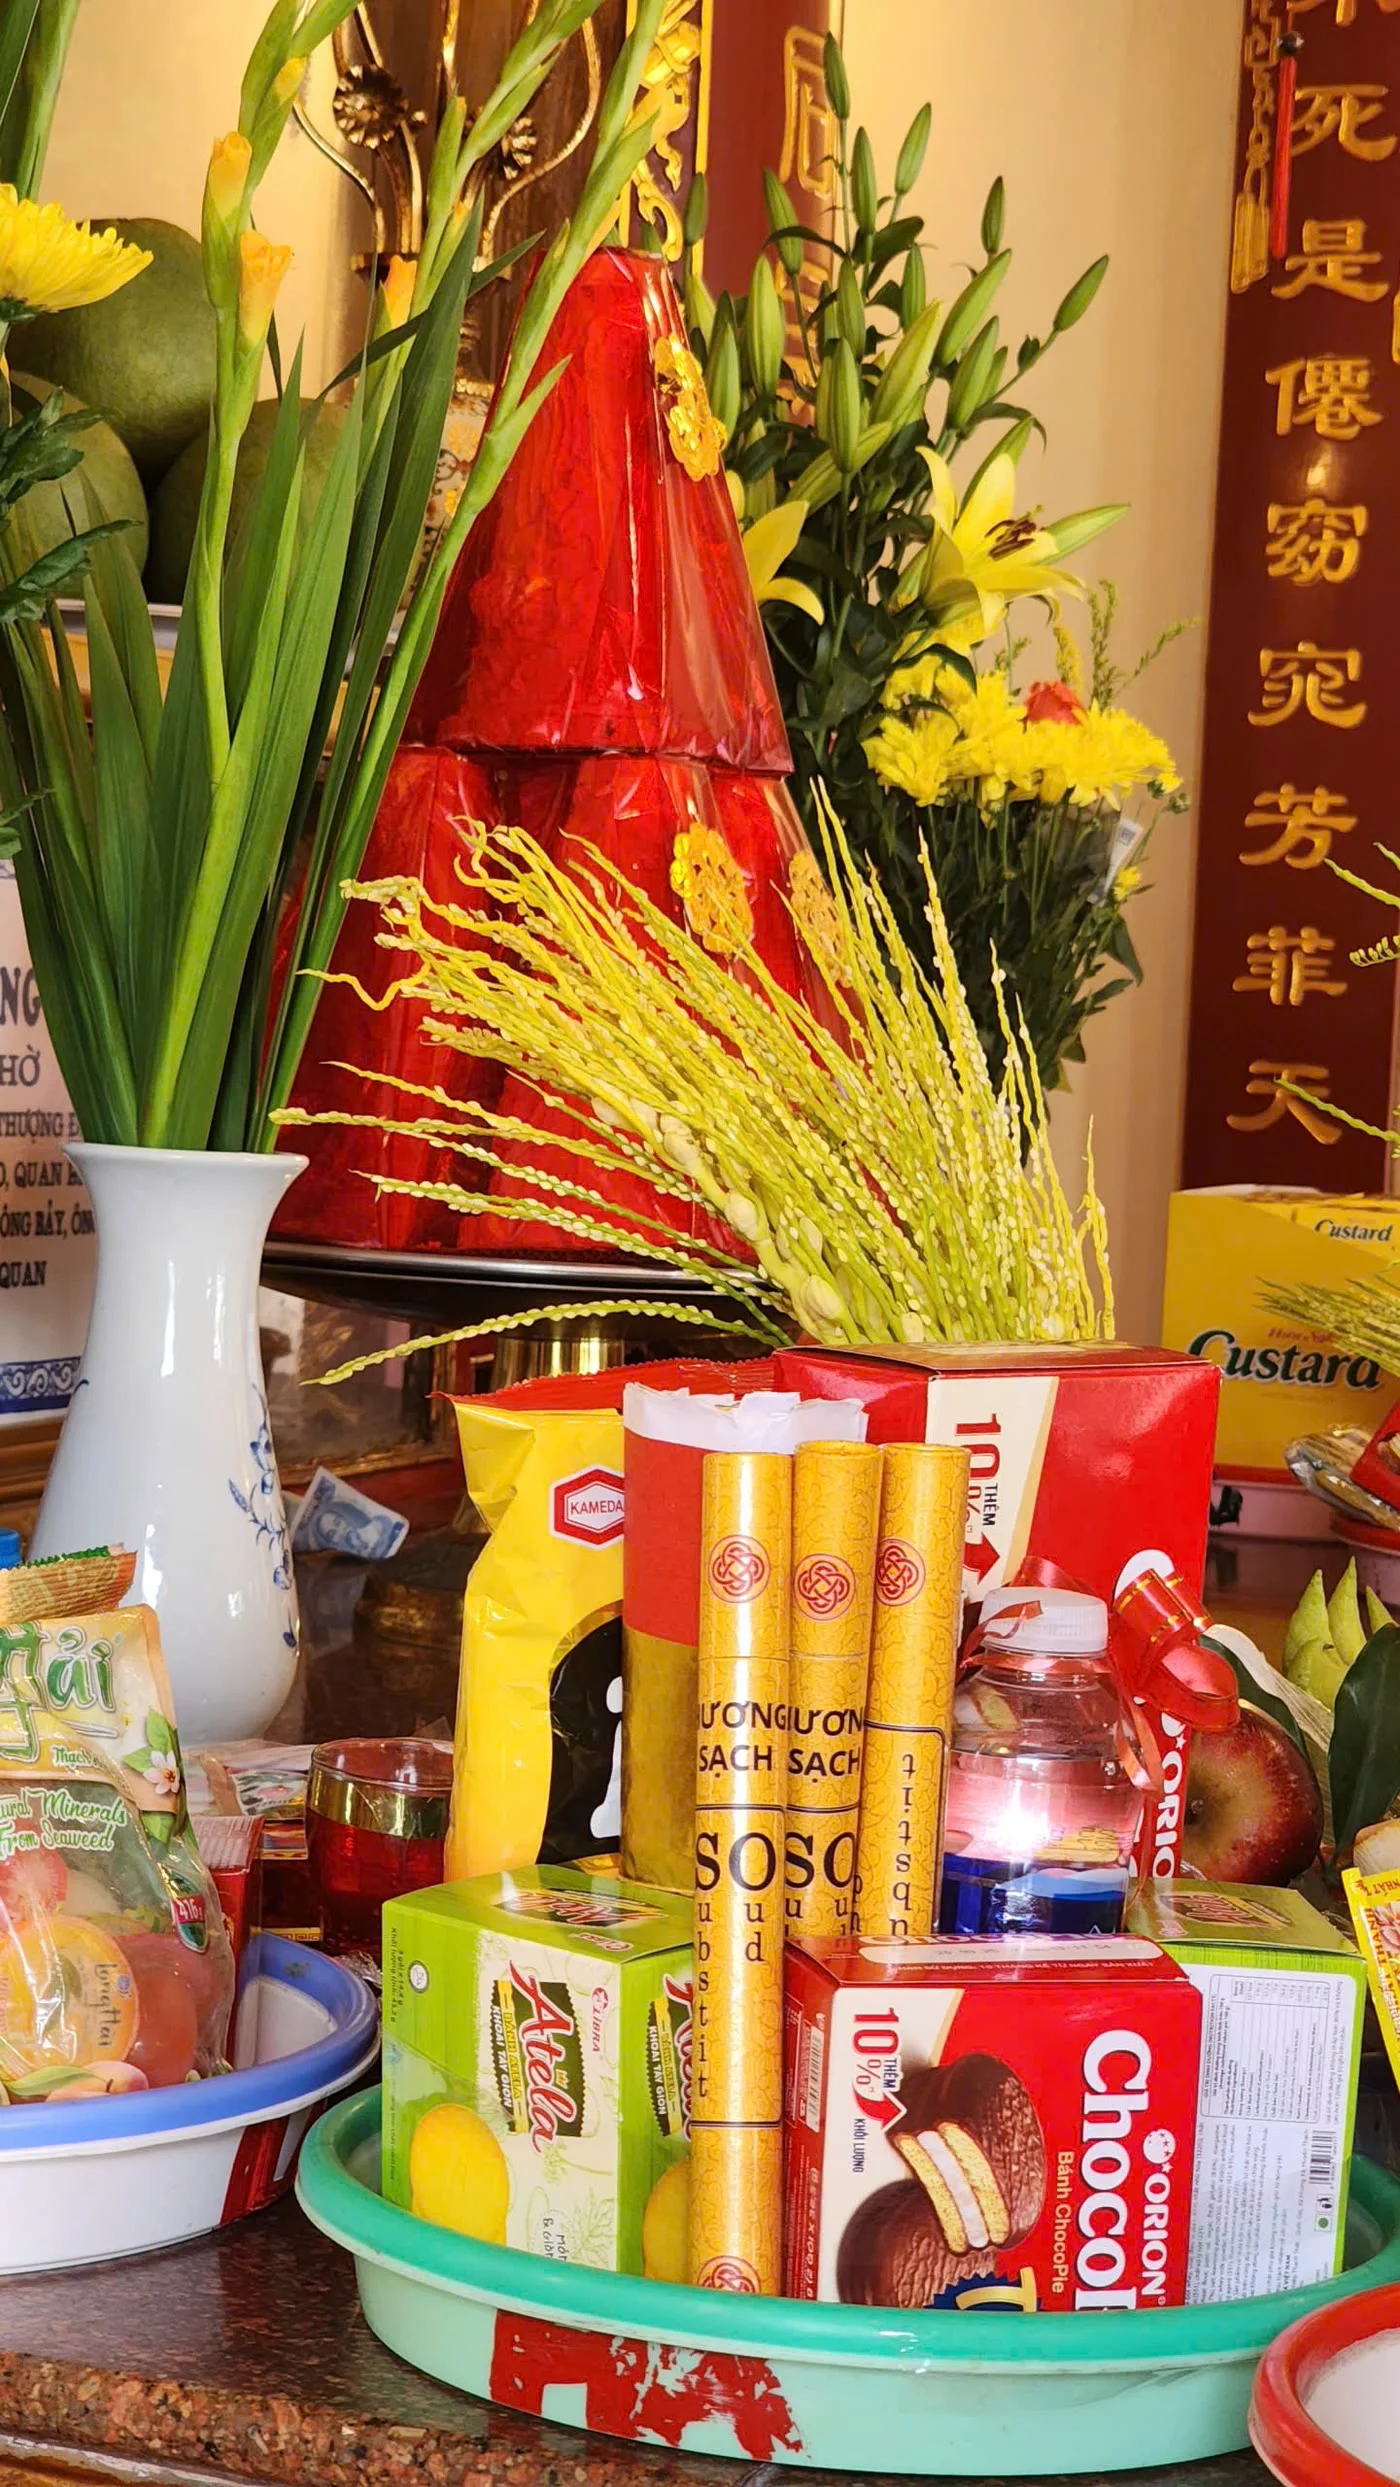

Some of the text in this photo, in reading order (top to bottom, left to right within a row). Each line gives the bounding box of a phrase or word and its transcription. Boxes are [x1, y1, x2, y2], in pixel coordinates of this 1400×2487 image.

[14, 1162, 62, 1188] QUAN
[1315, 1218, 1393, 1242] Custard
[0, 1261, 47, 1288] QUAN
[570, 1499, 625, 1515] KAMEDA
[982, 1483, 1000, 1526] THÊM
[699, 1745, 772, 1778] SẠCH
[28, 1788, 128, 1826] Minerals
[41, 1817, 117, 1851] Seaweed
[492, 2005, 505, 2048] KHOAI
[650, 2026, 660, 2062] KHOAI
[509, 1960, 576, 2153] Atela
[853, 2007, 900, 2085] 10%
[883, 2058, 899, 2089] THÊM
[1051, 2151, 1075, 2294] Bánh ChocoPie
[1141, 2174, 1172, 2297] ORION
